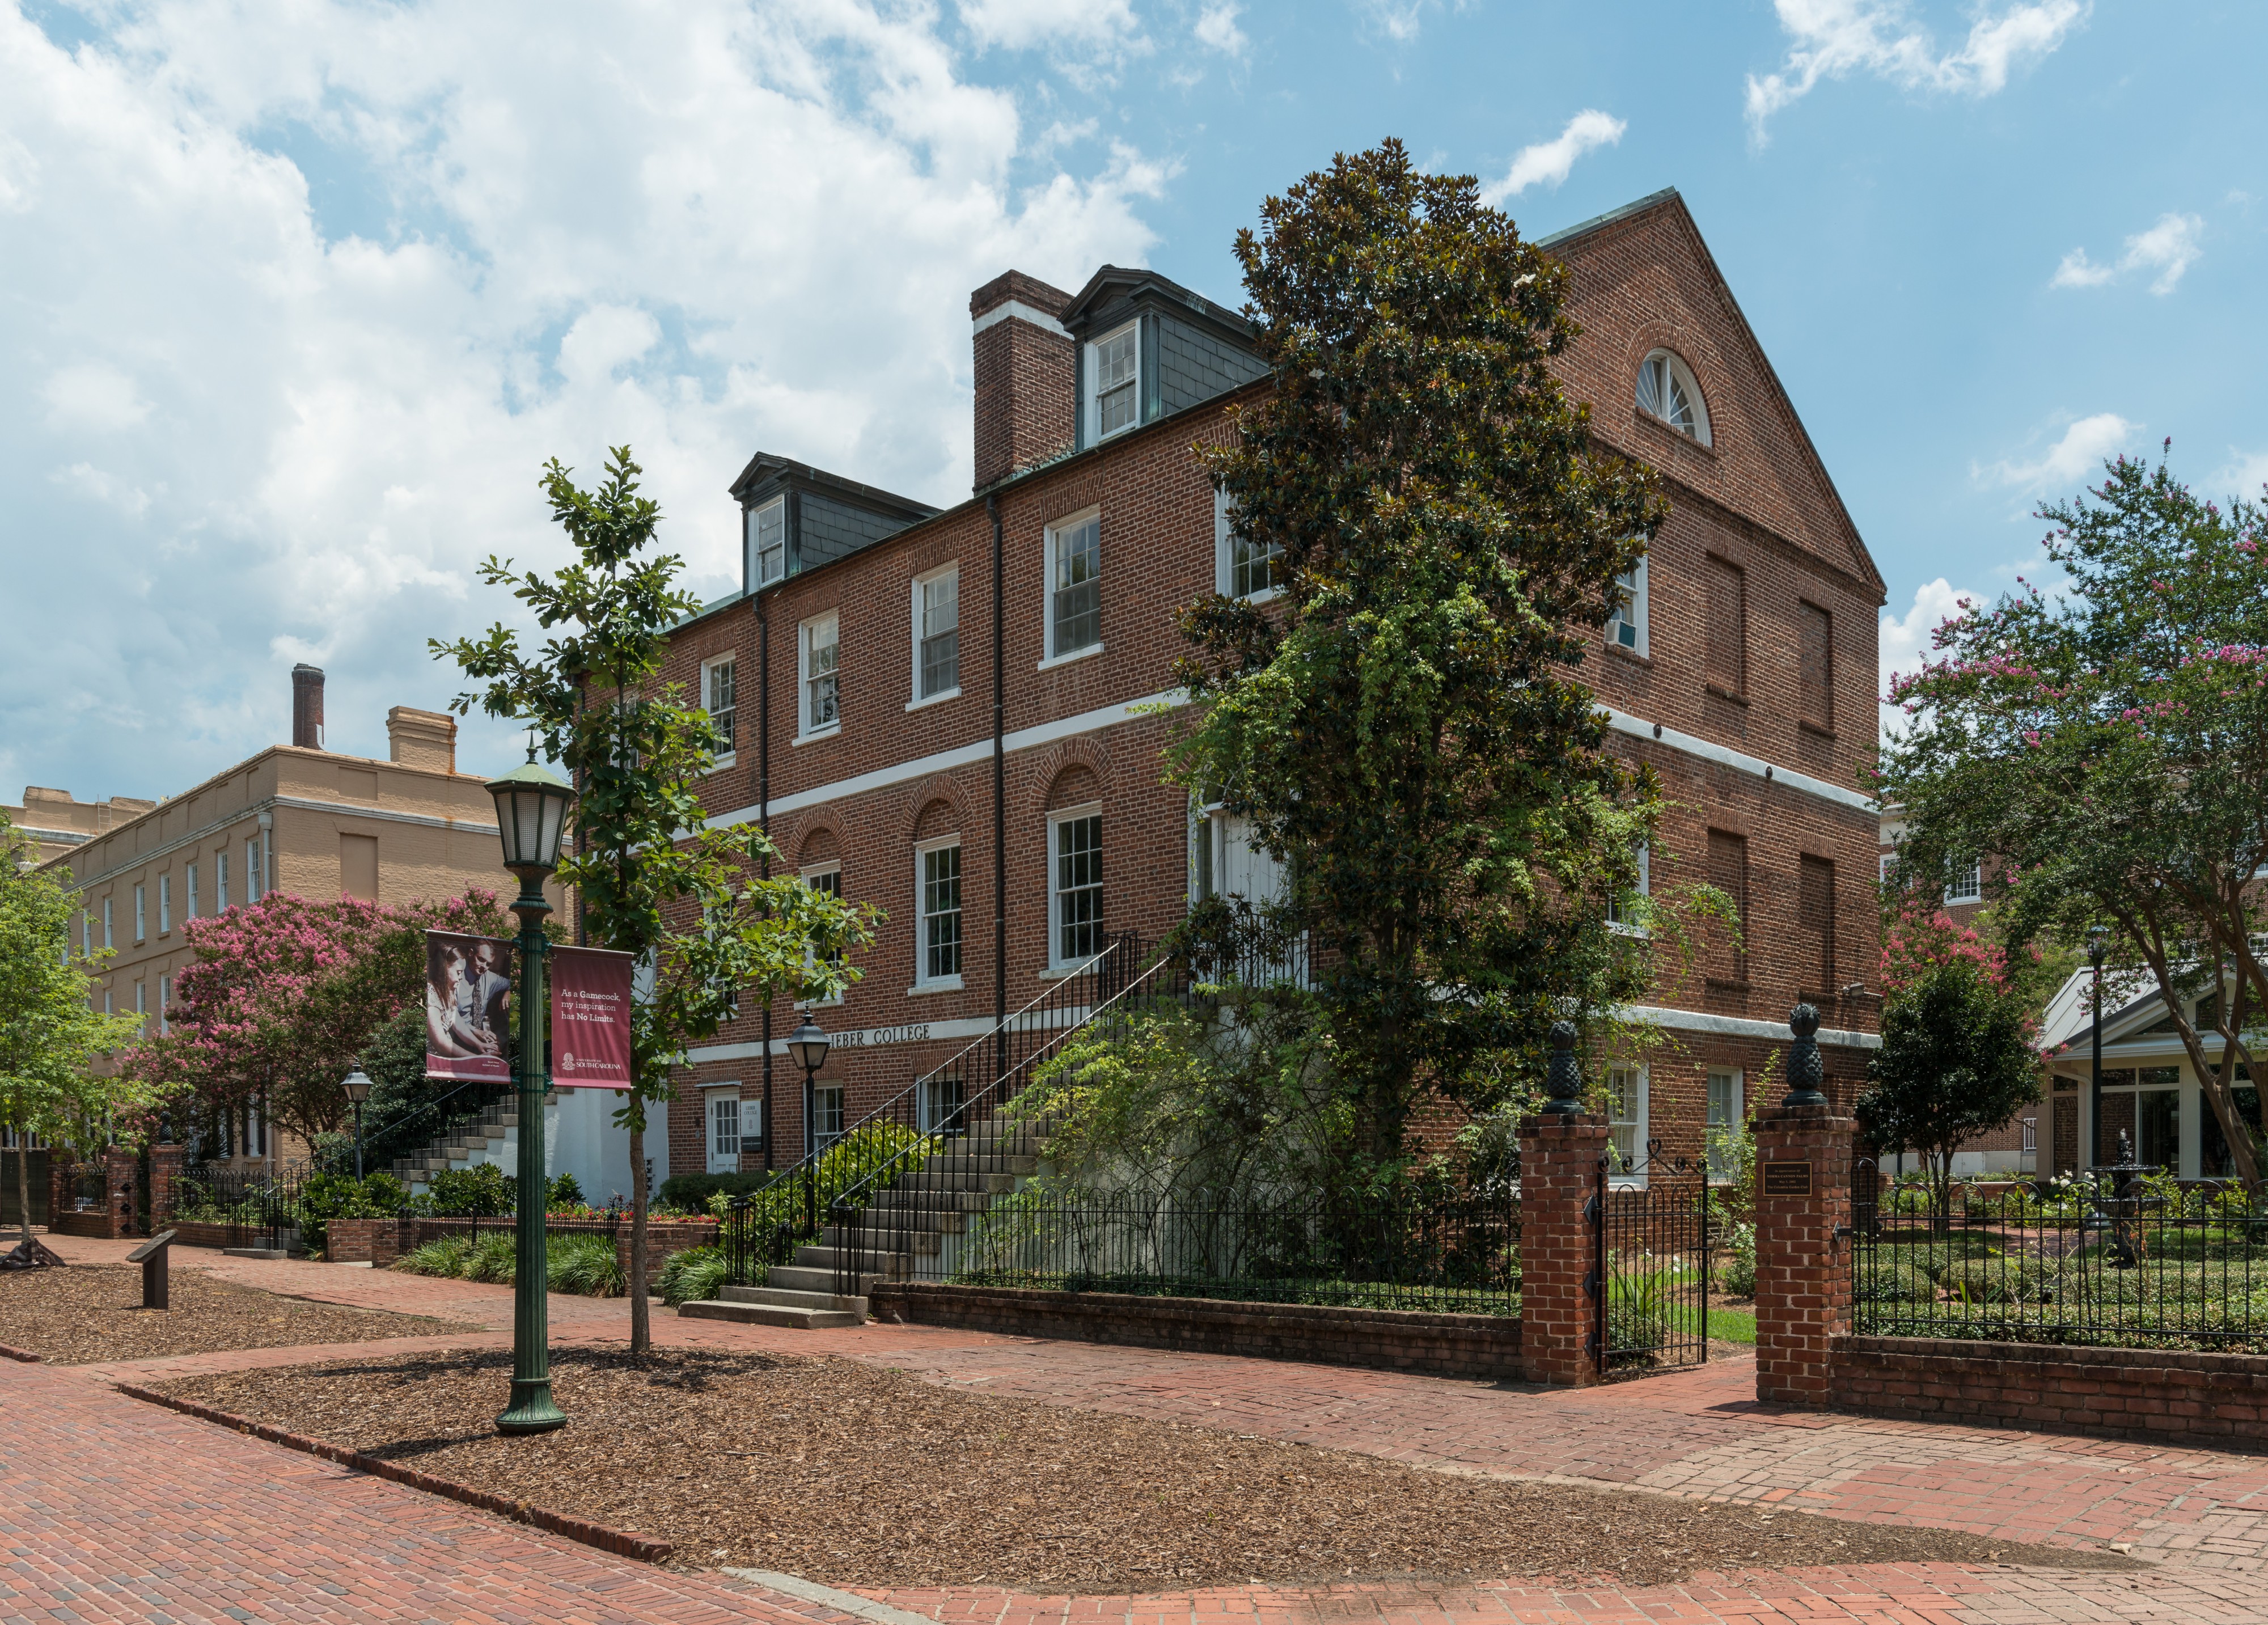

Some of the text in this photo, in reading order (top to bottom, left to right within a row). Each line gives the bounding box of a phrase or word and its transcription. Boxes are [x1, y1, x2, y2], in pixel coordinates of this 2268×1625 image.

[561, 989, 572, 997] As
[579, 991, 621, 1002] Gamecock,
[576, 1001, 616, 1011] inspiration
[561, 1011, 575, 1019] has
[589, 1014, 615, 1022] Limits.
[874, 1025, 930, 1044] COLLEGE
